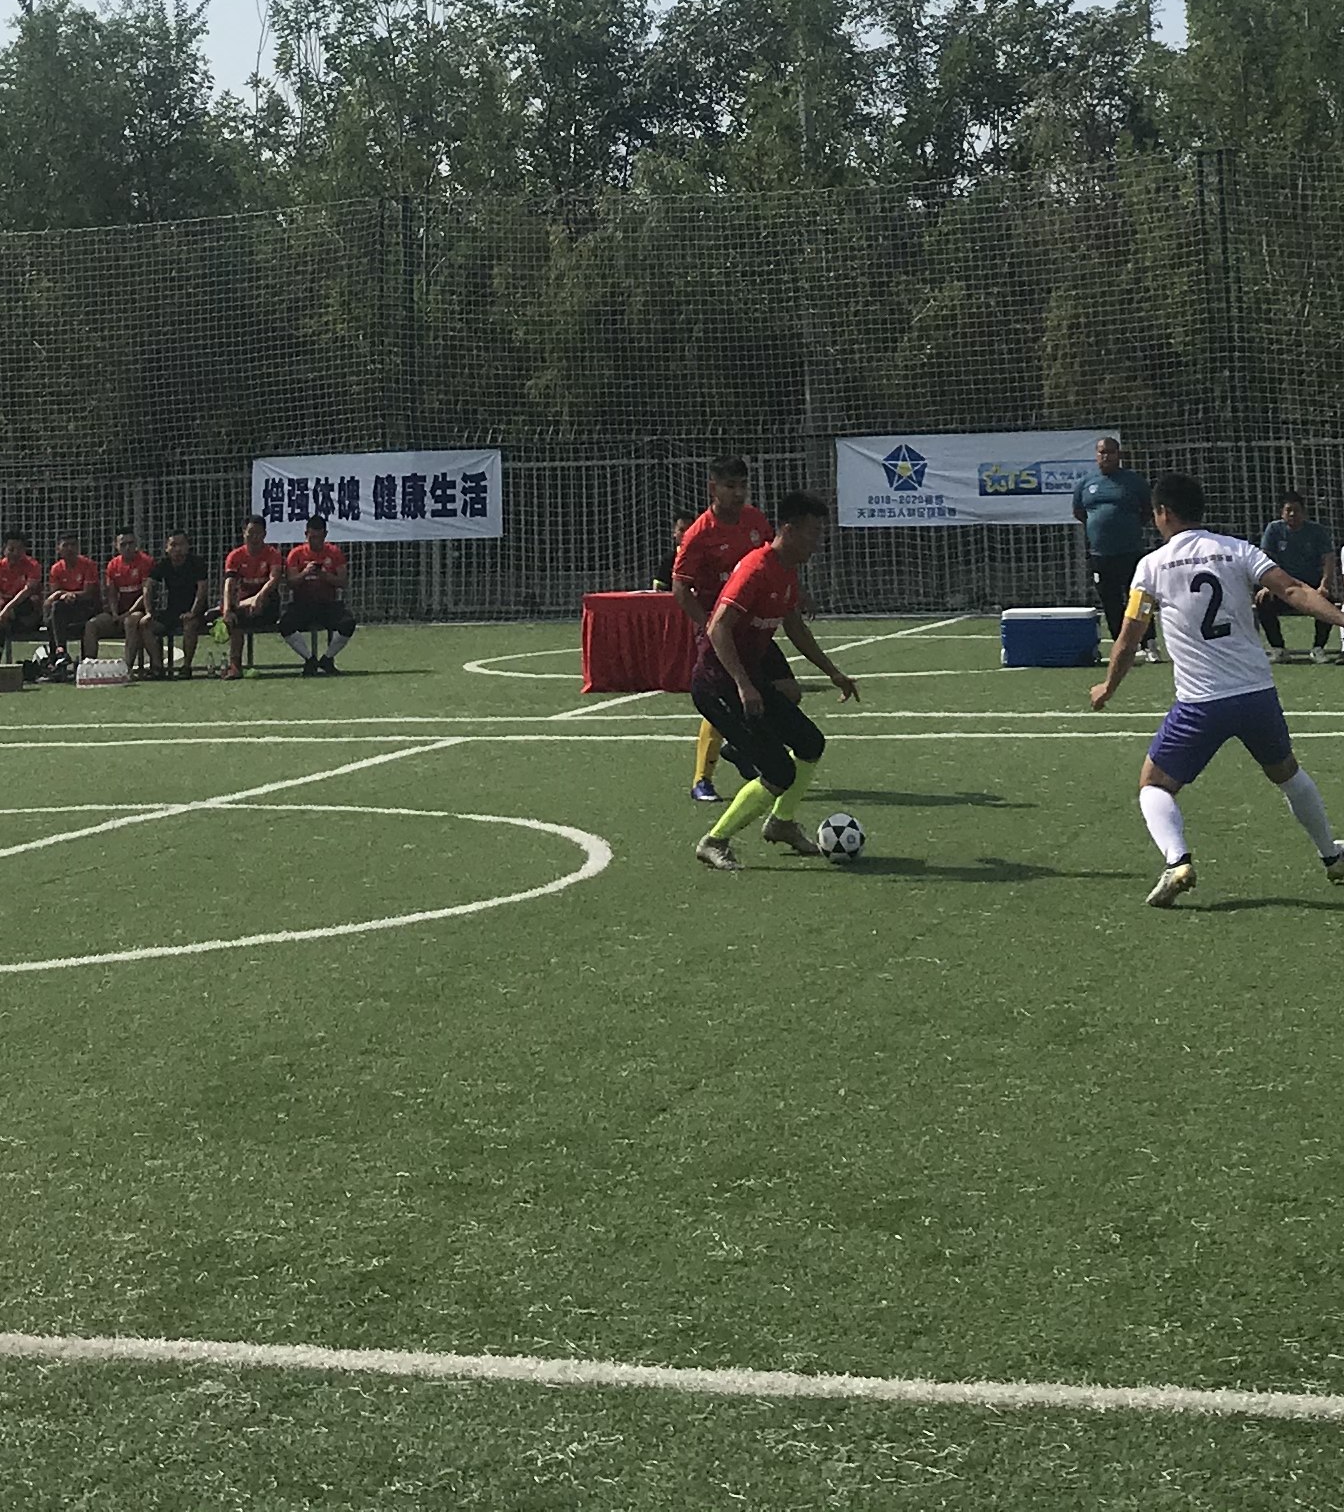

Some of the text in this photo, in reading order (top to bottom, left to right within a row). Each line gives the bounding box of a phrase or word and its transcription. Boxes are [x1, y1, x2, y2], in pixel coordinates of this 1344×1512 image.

[262, 471, 488, 522] 增强体魄 健康生活
[1190, 572, 1231, 640] 2
